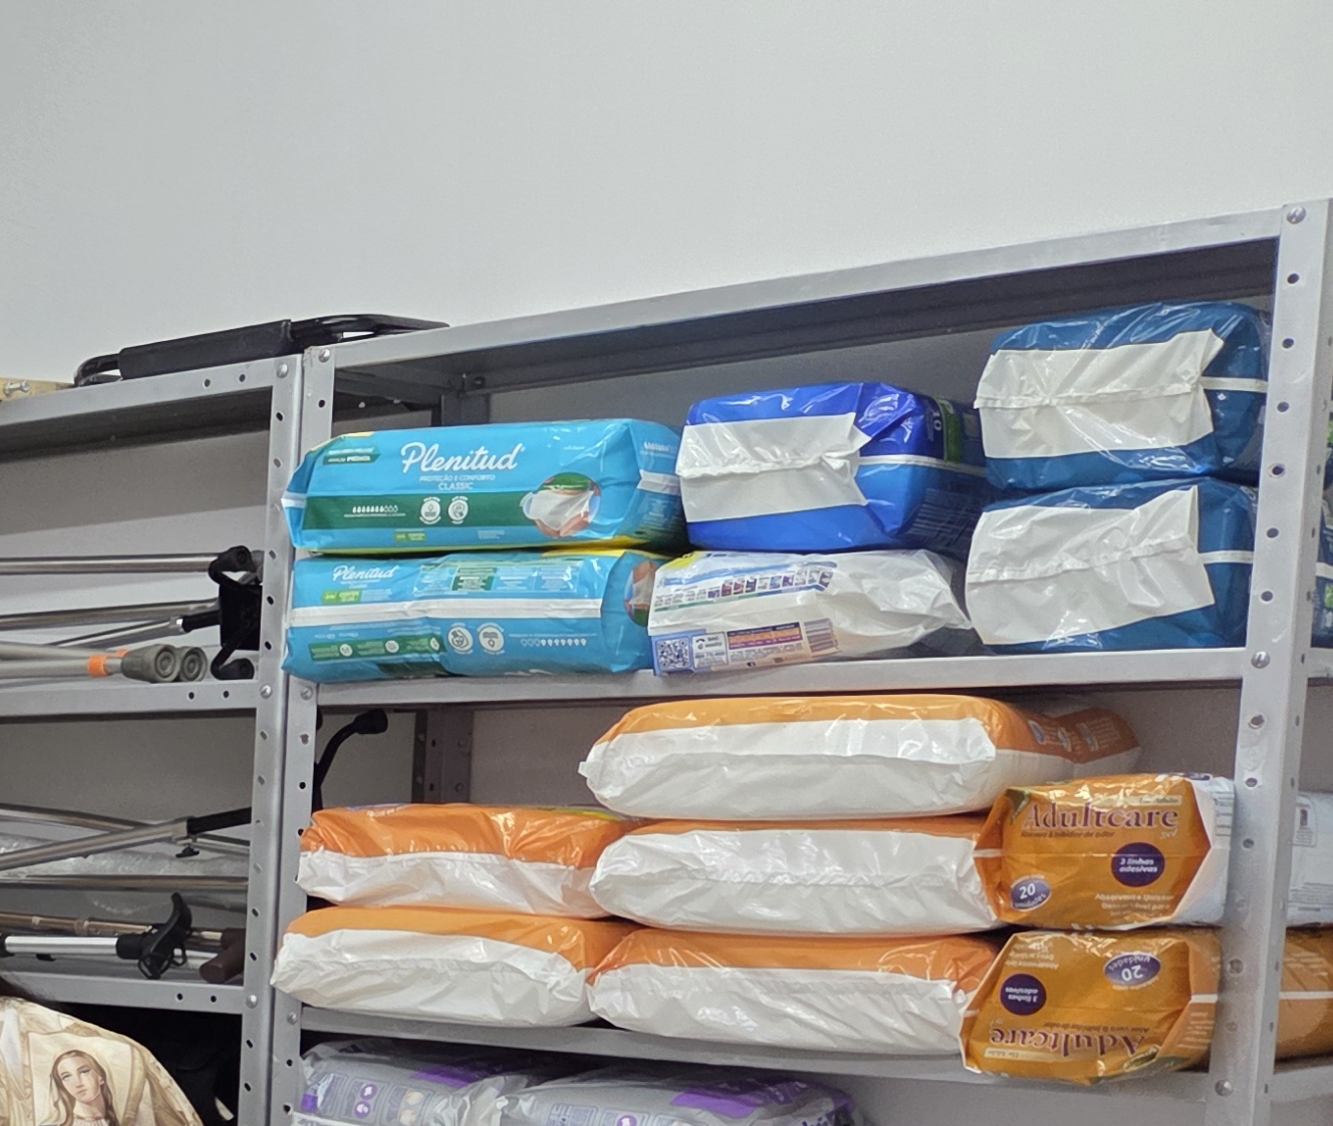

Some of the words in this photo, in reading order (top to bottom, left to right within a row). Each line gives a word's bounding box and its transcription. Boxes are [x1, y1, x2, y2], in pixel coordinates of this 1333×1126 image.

[400, 441, 523, 474] Plenitud
[438, 482, 474, 491] CLASSIC
[332, 564, 399, 582] Plenitud
[1022, 802, 1179, 831] Adultcare
[1119, 857, 1126, 865] 3
[1127, 857, 1154, 865] linhas
[1119, 865, 1158, 873] adesivas
[1019, 883, 1036, 900] 20
[1121, 964, 1144, 982] 20
[1007, 994, 1031, 1002] linhas
[990, 1027, 1147, 1057] Adultcare
